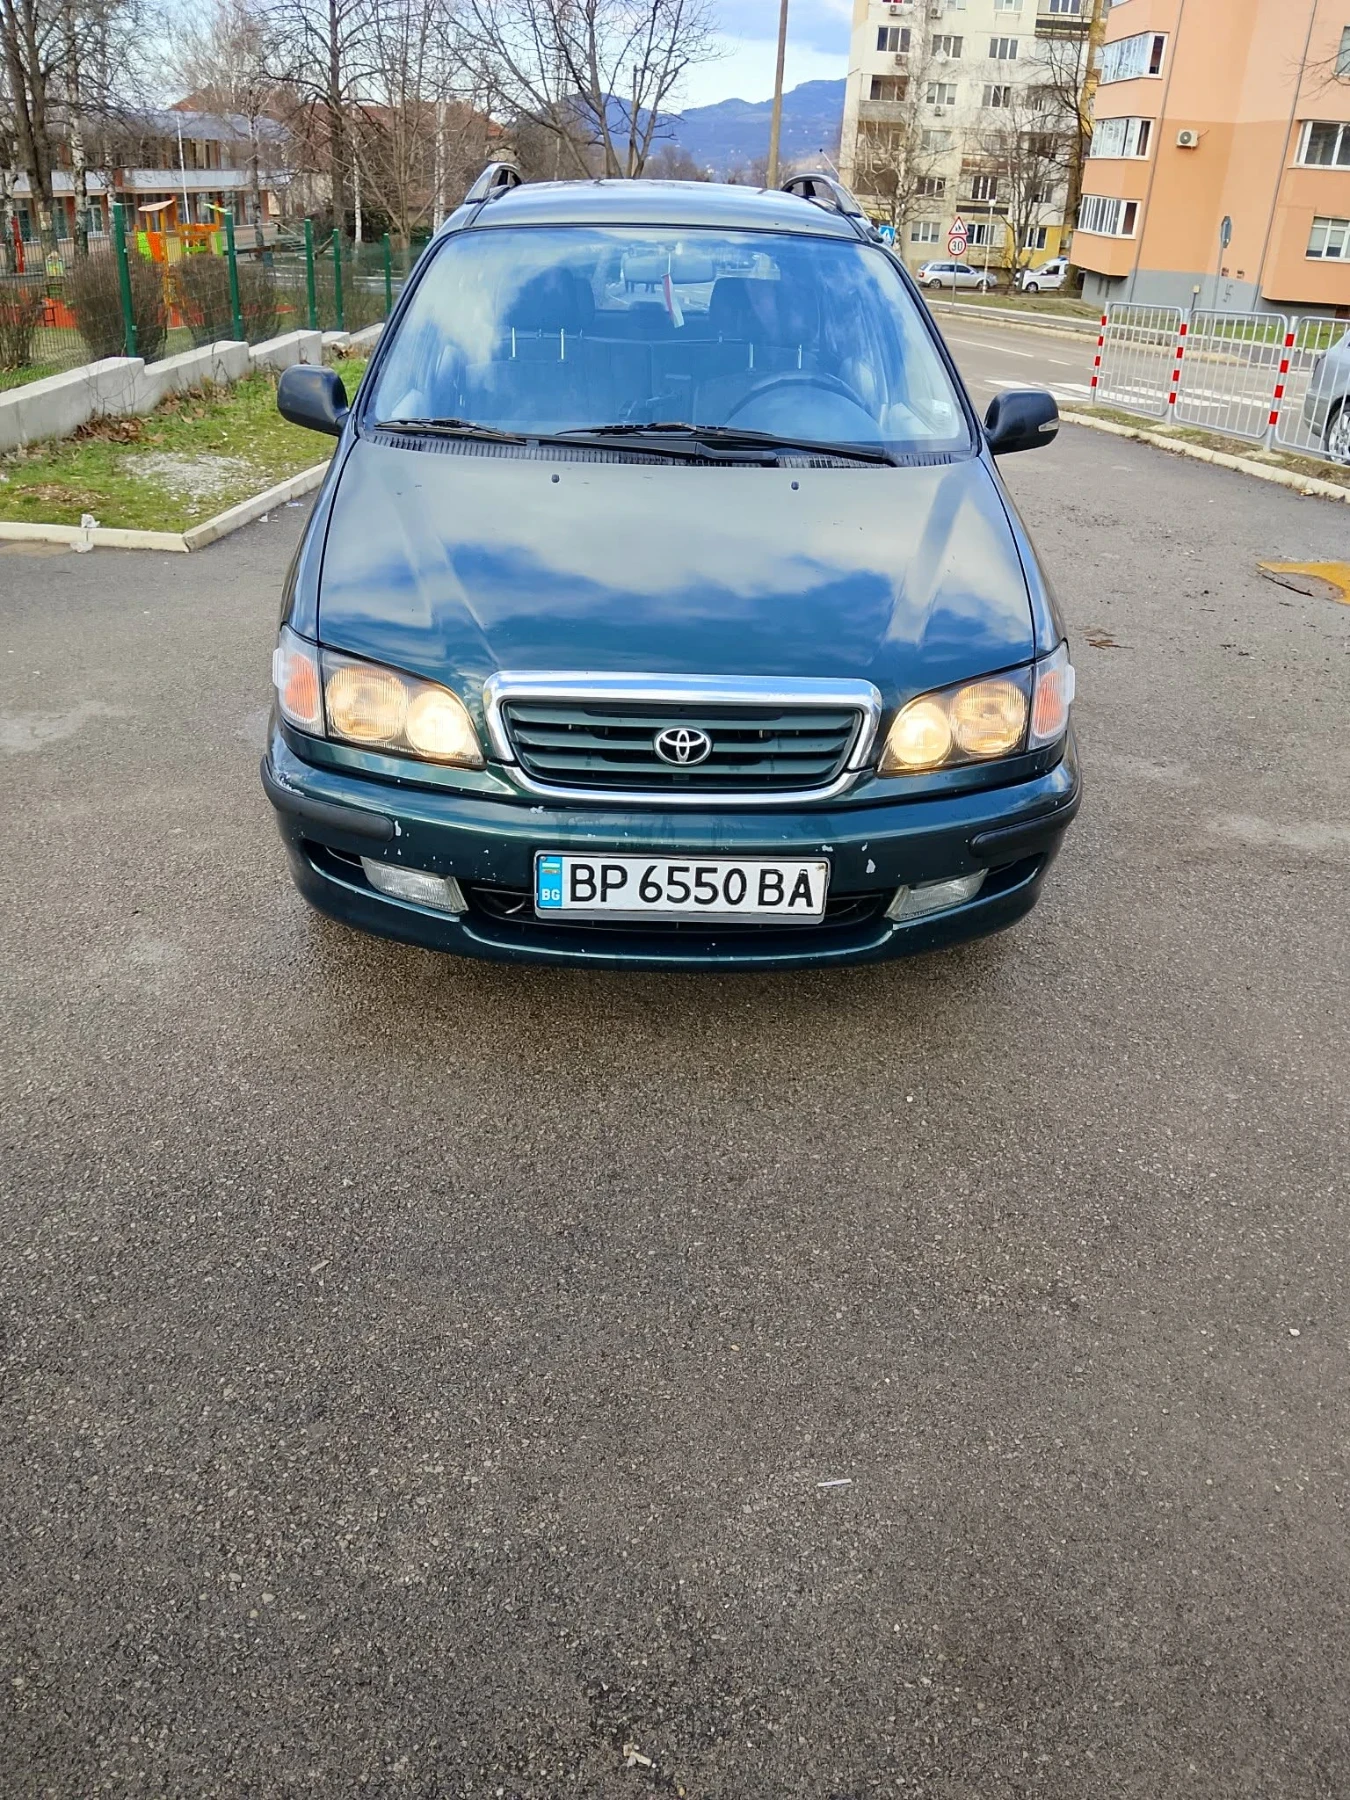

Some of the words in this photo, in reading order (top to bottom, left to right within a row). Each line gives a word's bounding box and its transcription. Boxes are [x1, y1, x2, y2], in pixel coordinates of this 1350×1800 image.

[951, 241, 963, 251] 30
[570, 863, 628, 903] BP
[638, 865, 748, 906] 6550
[758, 868, 814, 908] BA
[541, 888, 561, 901] BG
